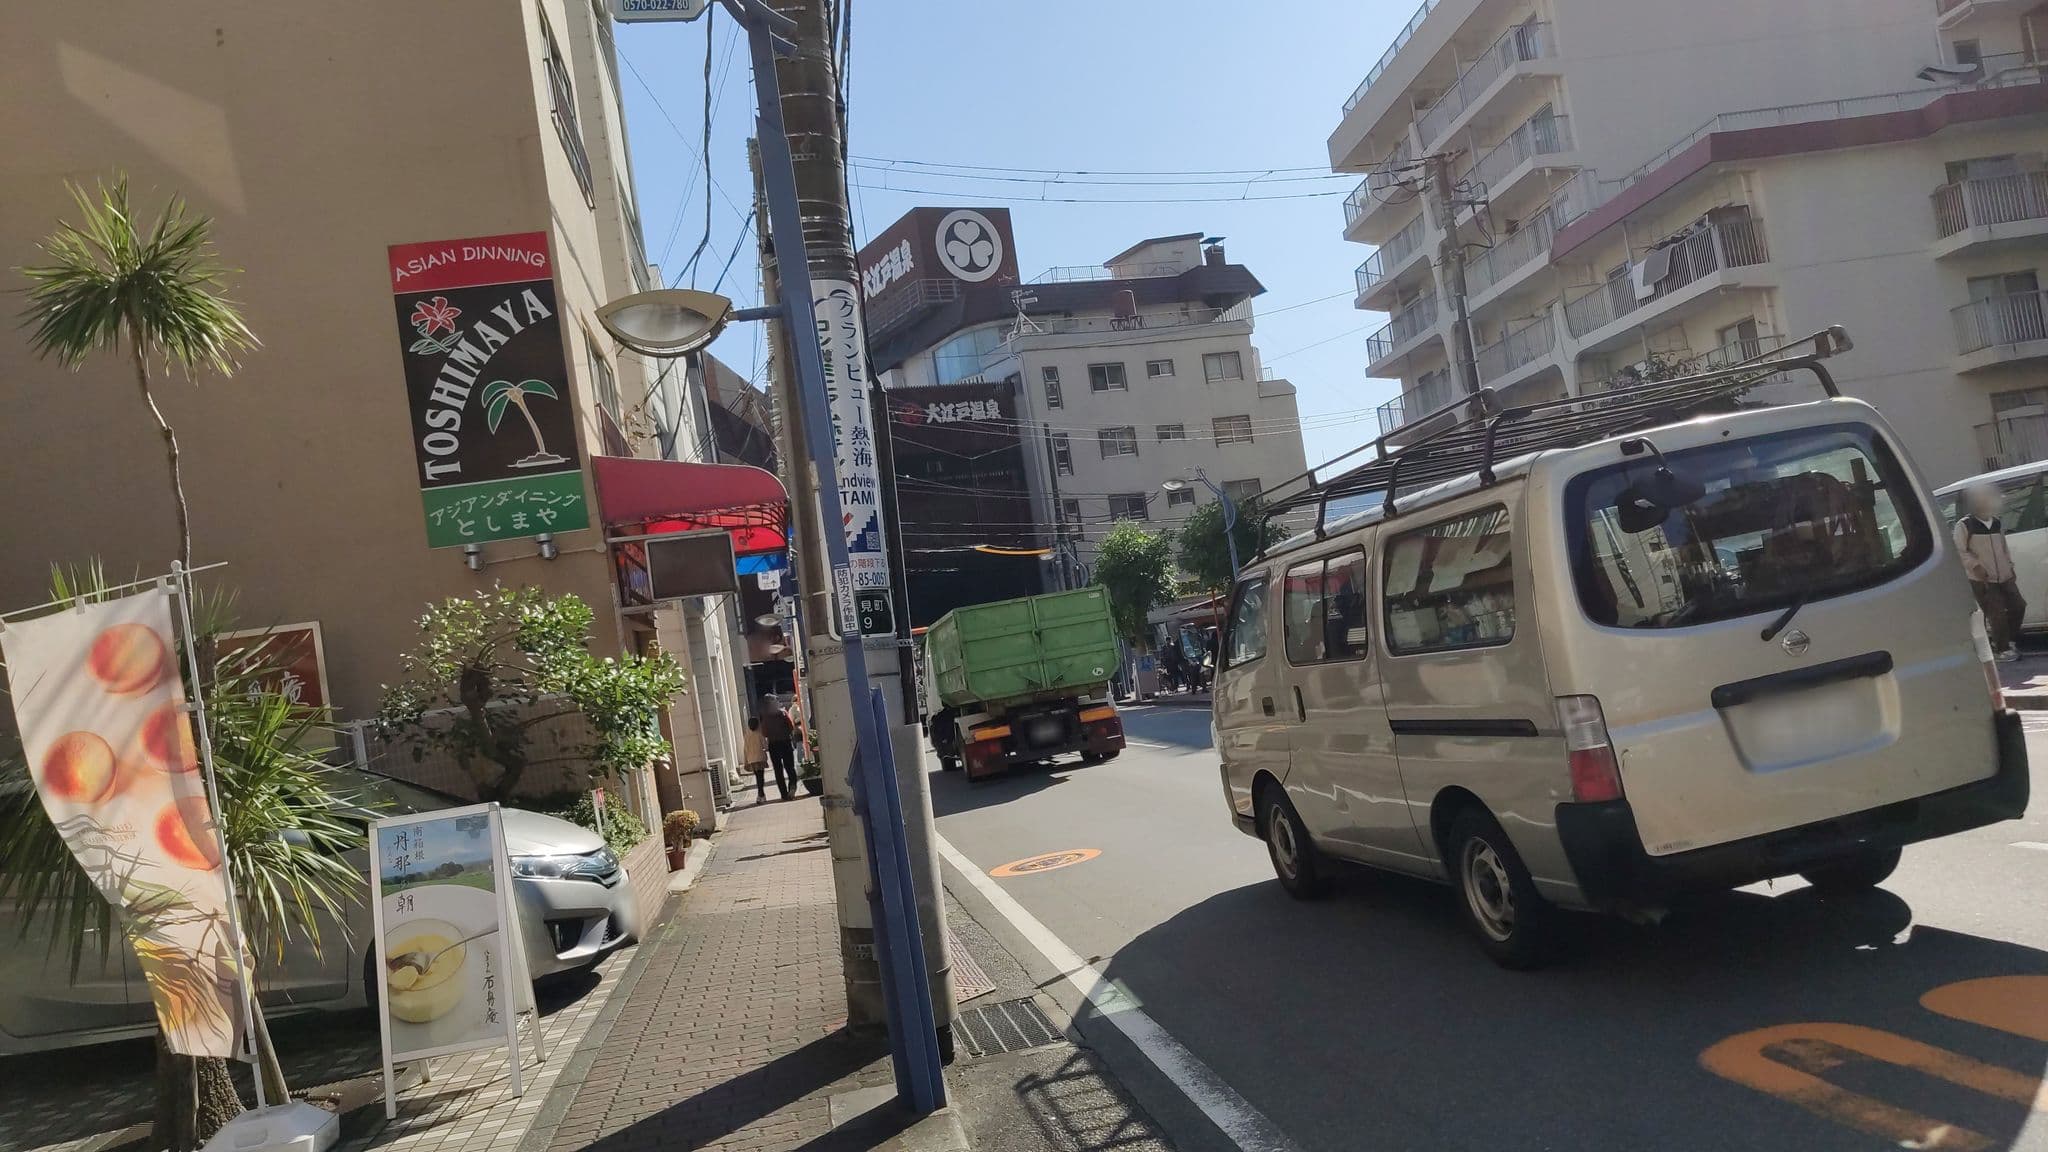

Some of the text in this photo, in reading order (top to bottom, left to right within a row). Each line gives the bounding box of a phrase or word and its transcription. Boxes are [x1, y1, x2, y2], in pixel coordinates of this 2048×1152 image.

[396, 246, 546, 282] ASIAN DINNING
[423, 288, 552, 481] TOSHIMAYA
[925, 399, 1002, 424] 大江戸温泉
[840, 473, 876, 489] ndview
[429, 489, 582, 527] アジアンダイニング
[840, 490, 876, 505] TAMI
[457, 508, 557, 536] としまや
[837, 569, 856, 630] 防犯カメラ作動中
[861, 600, 884, 612] 見町
[864, 617, 873, 629] 9
